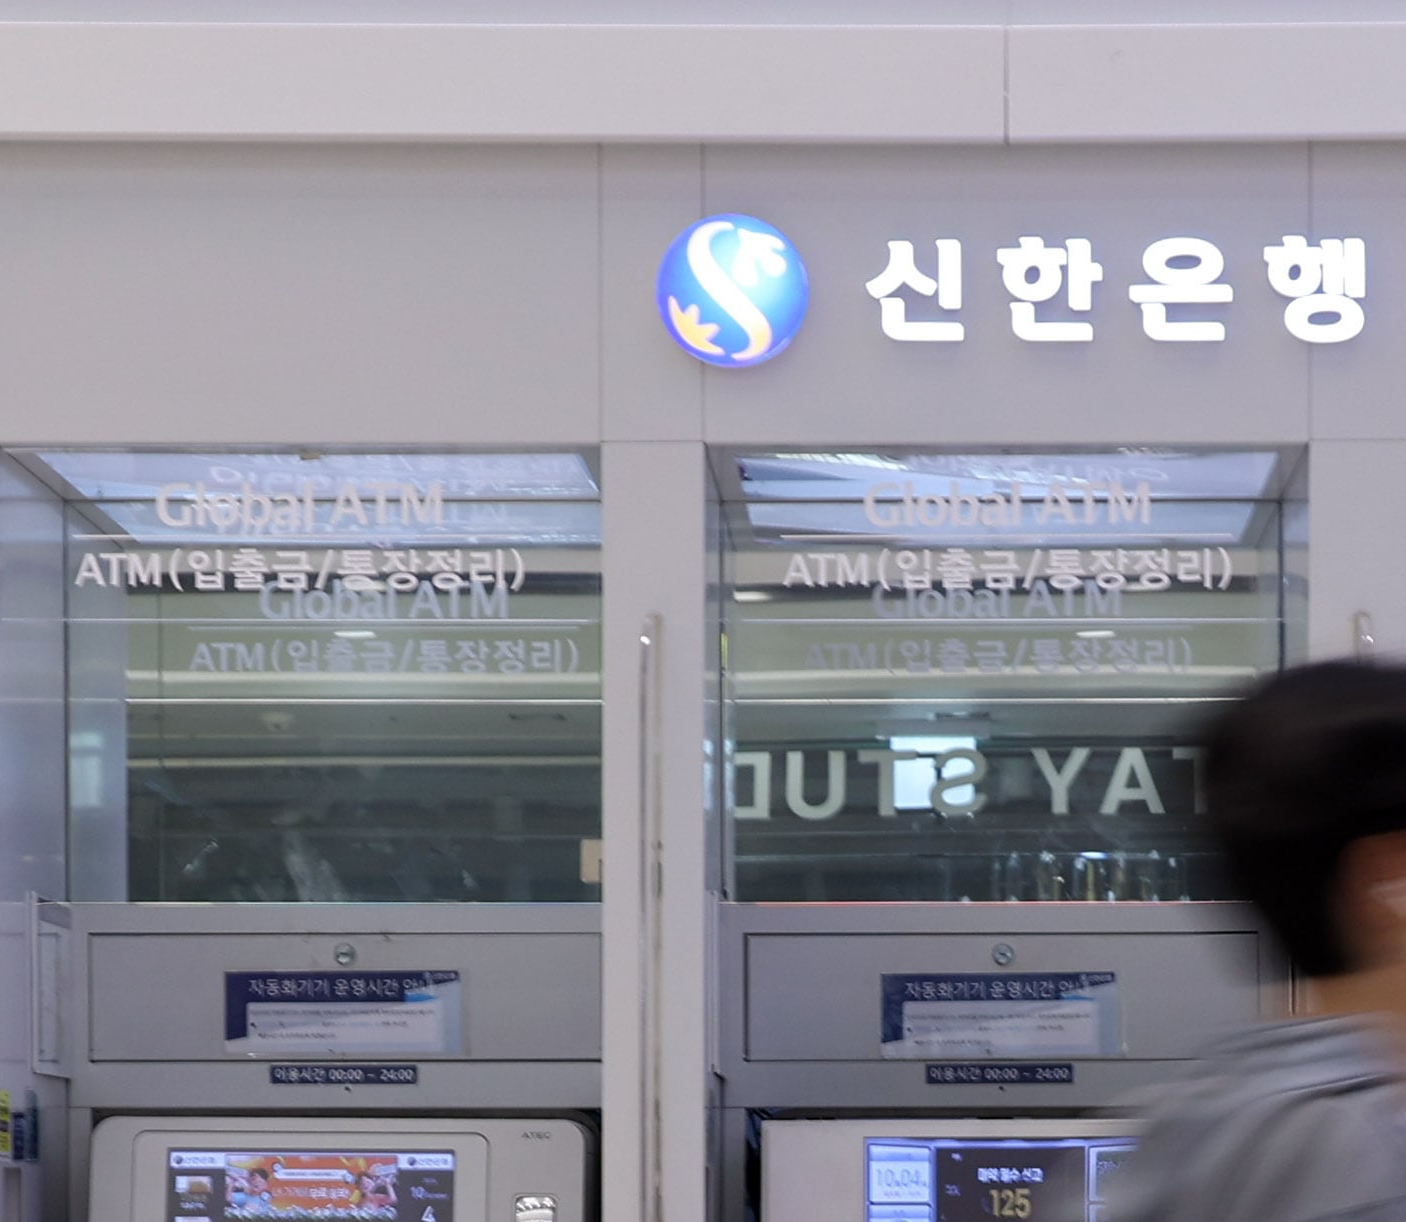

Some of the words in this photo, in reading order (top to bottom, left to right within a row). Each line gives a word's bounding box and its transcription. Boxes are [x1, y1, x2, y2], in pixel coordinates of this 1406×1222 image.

[865, 234, 1367, 343] 신한은행
[155, 484, 315, 528] Global
[330, 483, 445, 526] ATM
[863, 482, 1020, 527] Global
[1033, 482, 1152, 525] ATM
[74, 548, 526, 592] ATM(입출금/통장정리)
[783, 548, 1235, 590] ATM(입출금/통장정리)
[260, 580, 395, 620] Global
[407, 578, 509, 620] ATM
[248, 978, 329, 996] 자동화기기
[333, 978, 399, 997] 운영시간
[905, 981, 987, 999] 자동화기기
[990, 981, 1054, 999] 운영시간
[329, 1068, 363, 1080] 00:00
[985, 1067, 1018, 1079] 00:00
[989, 1188, 1031, 1219] 125
